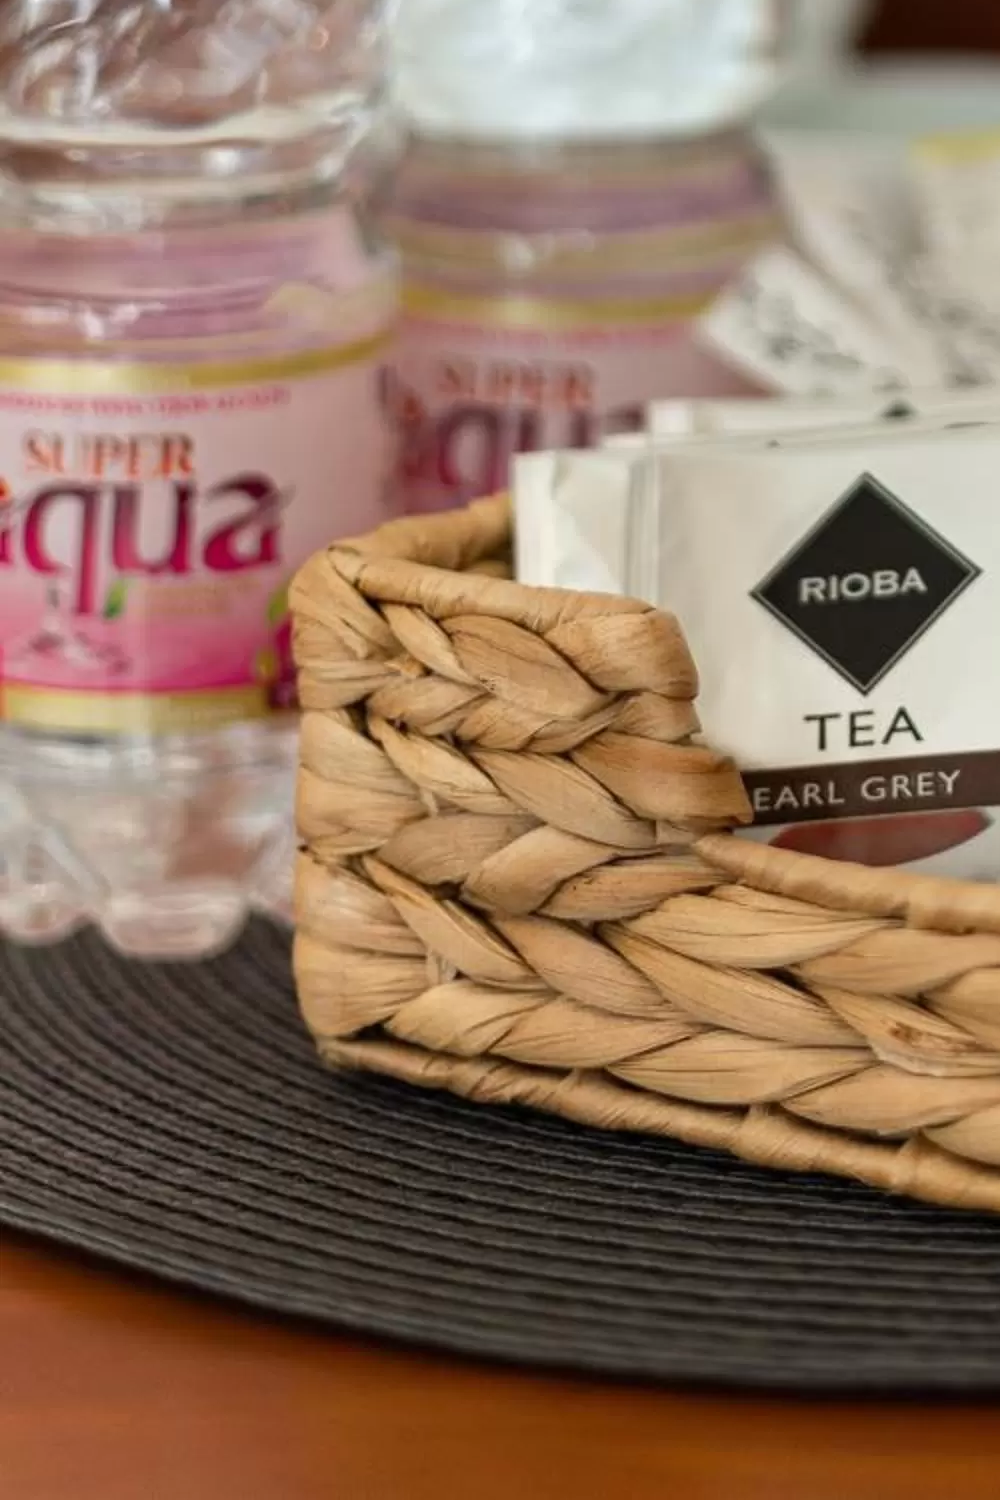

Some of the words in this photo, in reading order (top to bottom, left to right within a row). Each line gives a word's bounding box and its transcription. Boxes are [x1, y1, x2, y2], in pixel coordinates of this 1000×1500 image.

[22, 428, 197, 477] SUPER
[0, 470, 290, 616] qua
[799, 566, 928, 604] RIOBA
[803, 706, 924, 751] TEA
[753, 781, 845, 811] EARL
[860, 769, 960, 801] GREY
